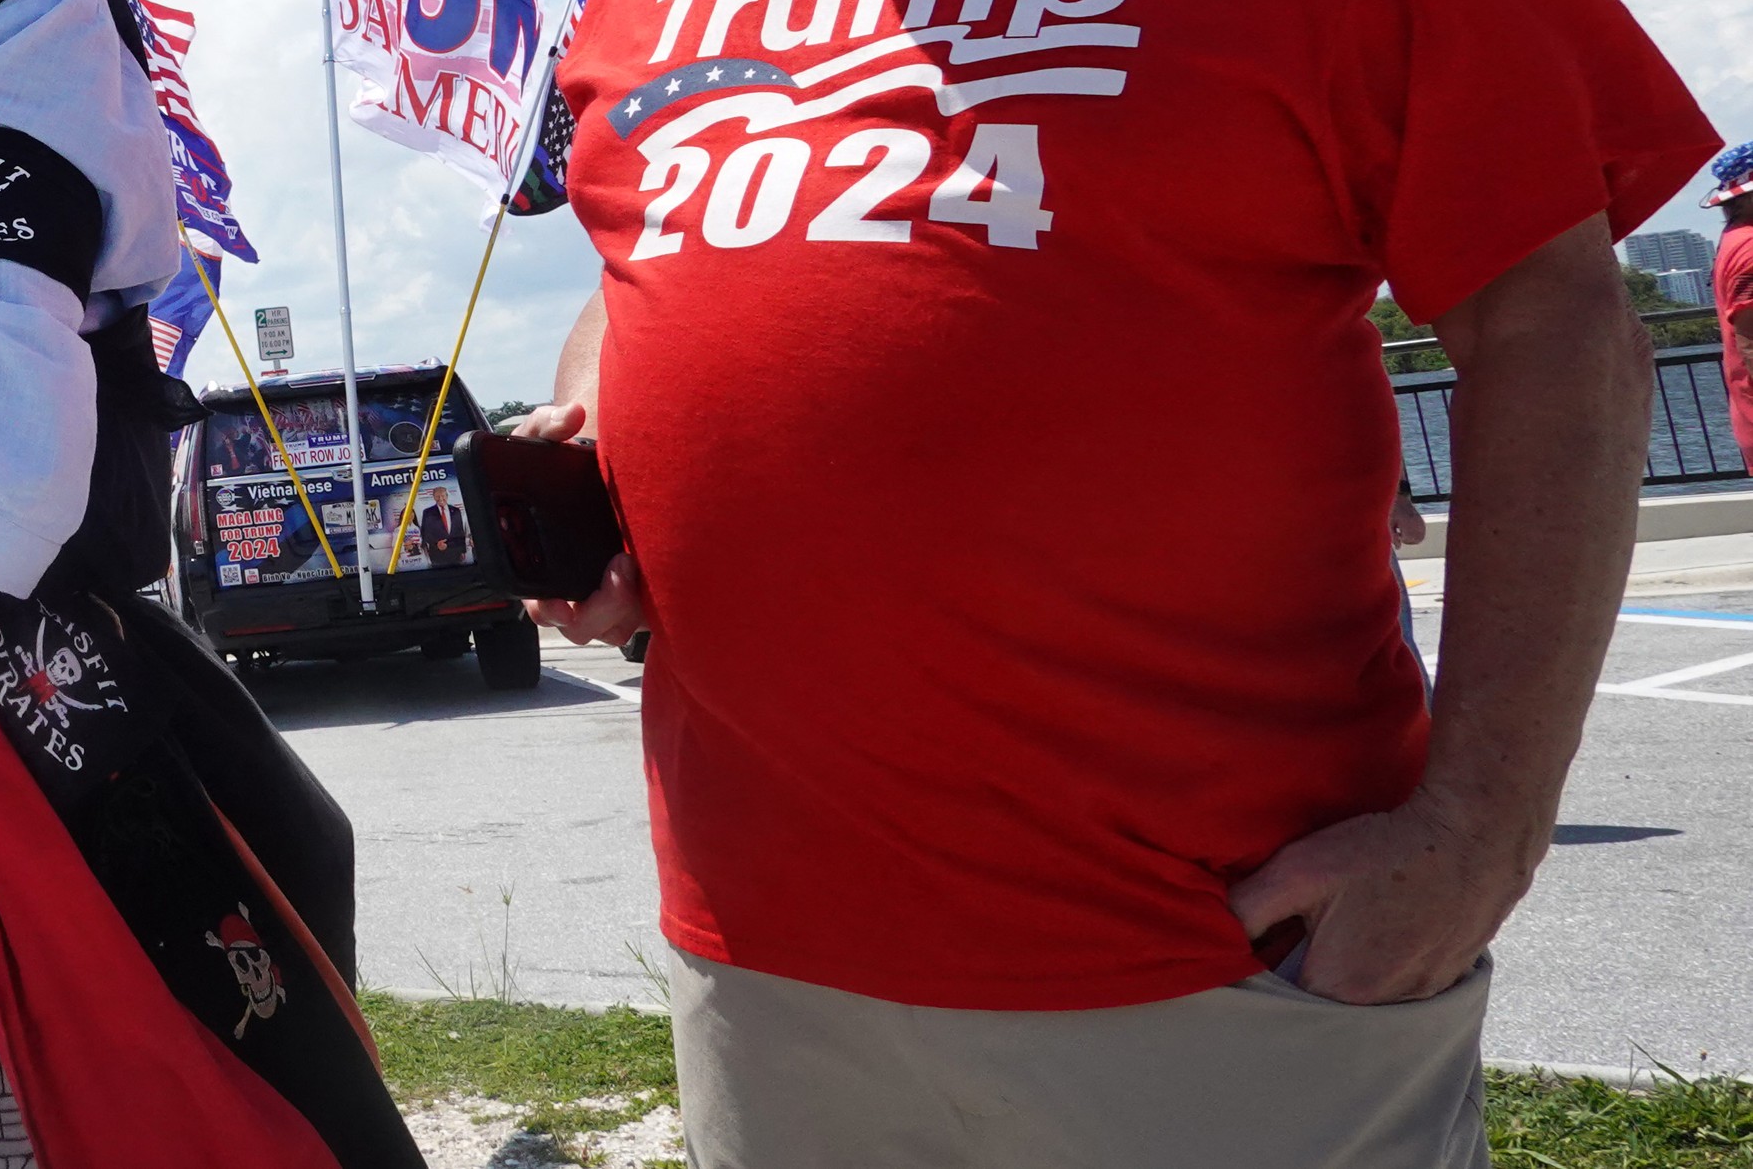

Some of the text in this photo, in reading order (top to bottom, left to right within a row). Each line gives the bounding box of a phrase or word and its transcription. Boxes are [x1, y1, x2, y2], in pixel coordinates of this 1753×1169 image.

[628, 123, 1055, 261] 2024
[256, 311, 266, 327] 2
[267, 317, 288, 325] PARKING
[311, 434, 348, 443] TRUMP
[310, 449, 335, 463] ROW
[338, 447, 365, 462] JOS
[216, 507, 284, 528] MAGA KING
[220, 524, 283, 541] FOR TRUMP
[227, 537, 281, 562] 2024
